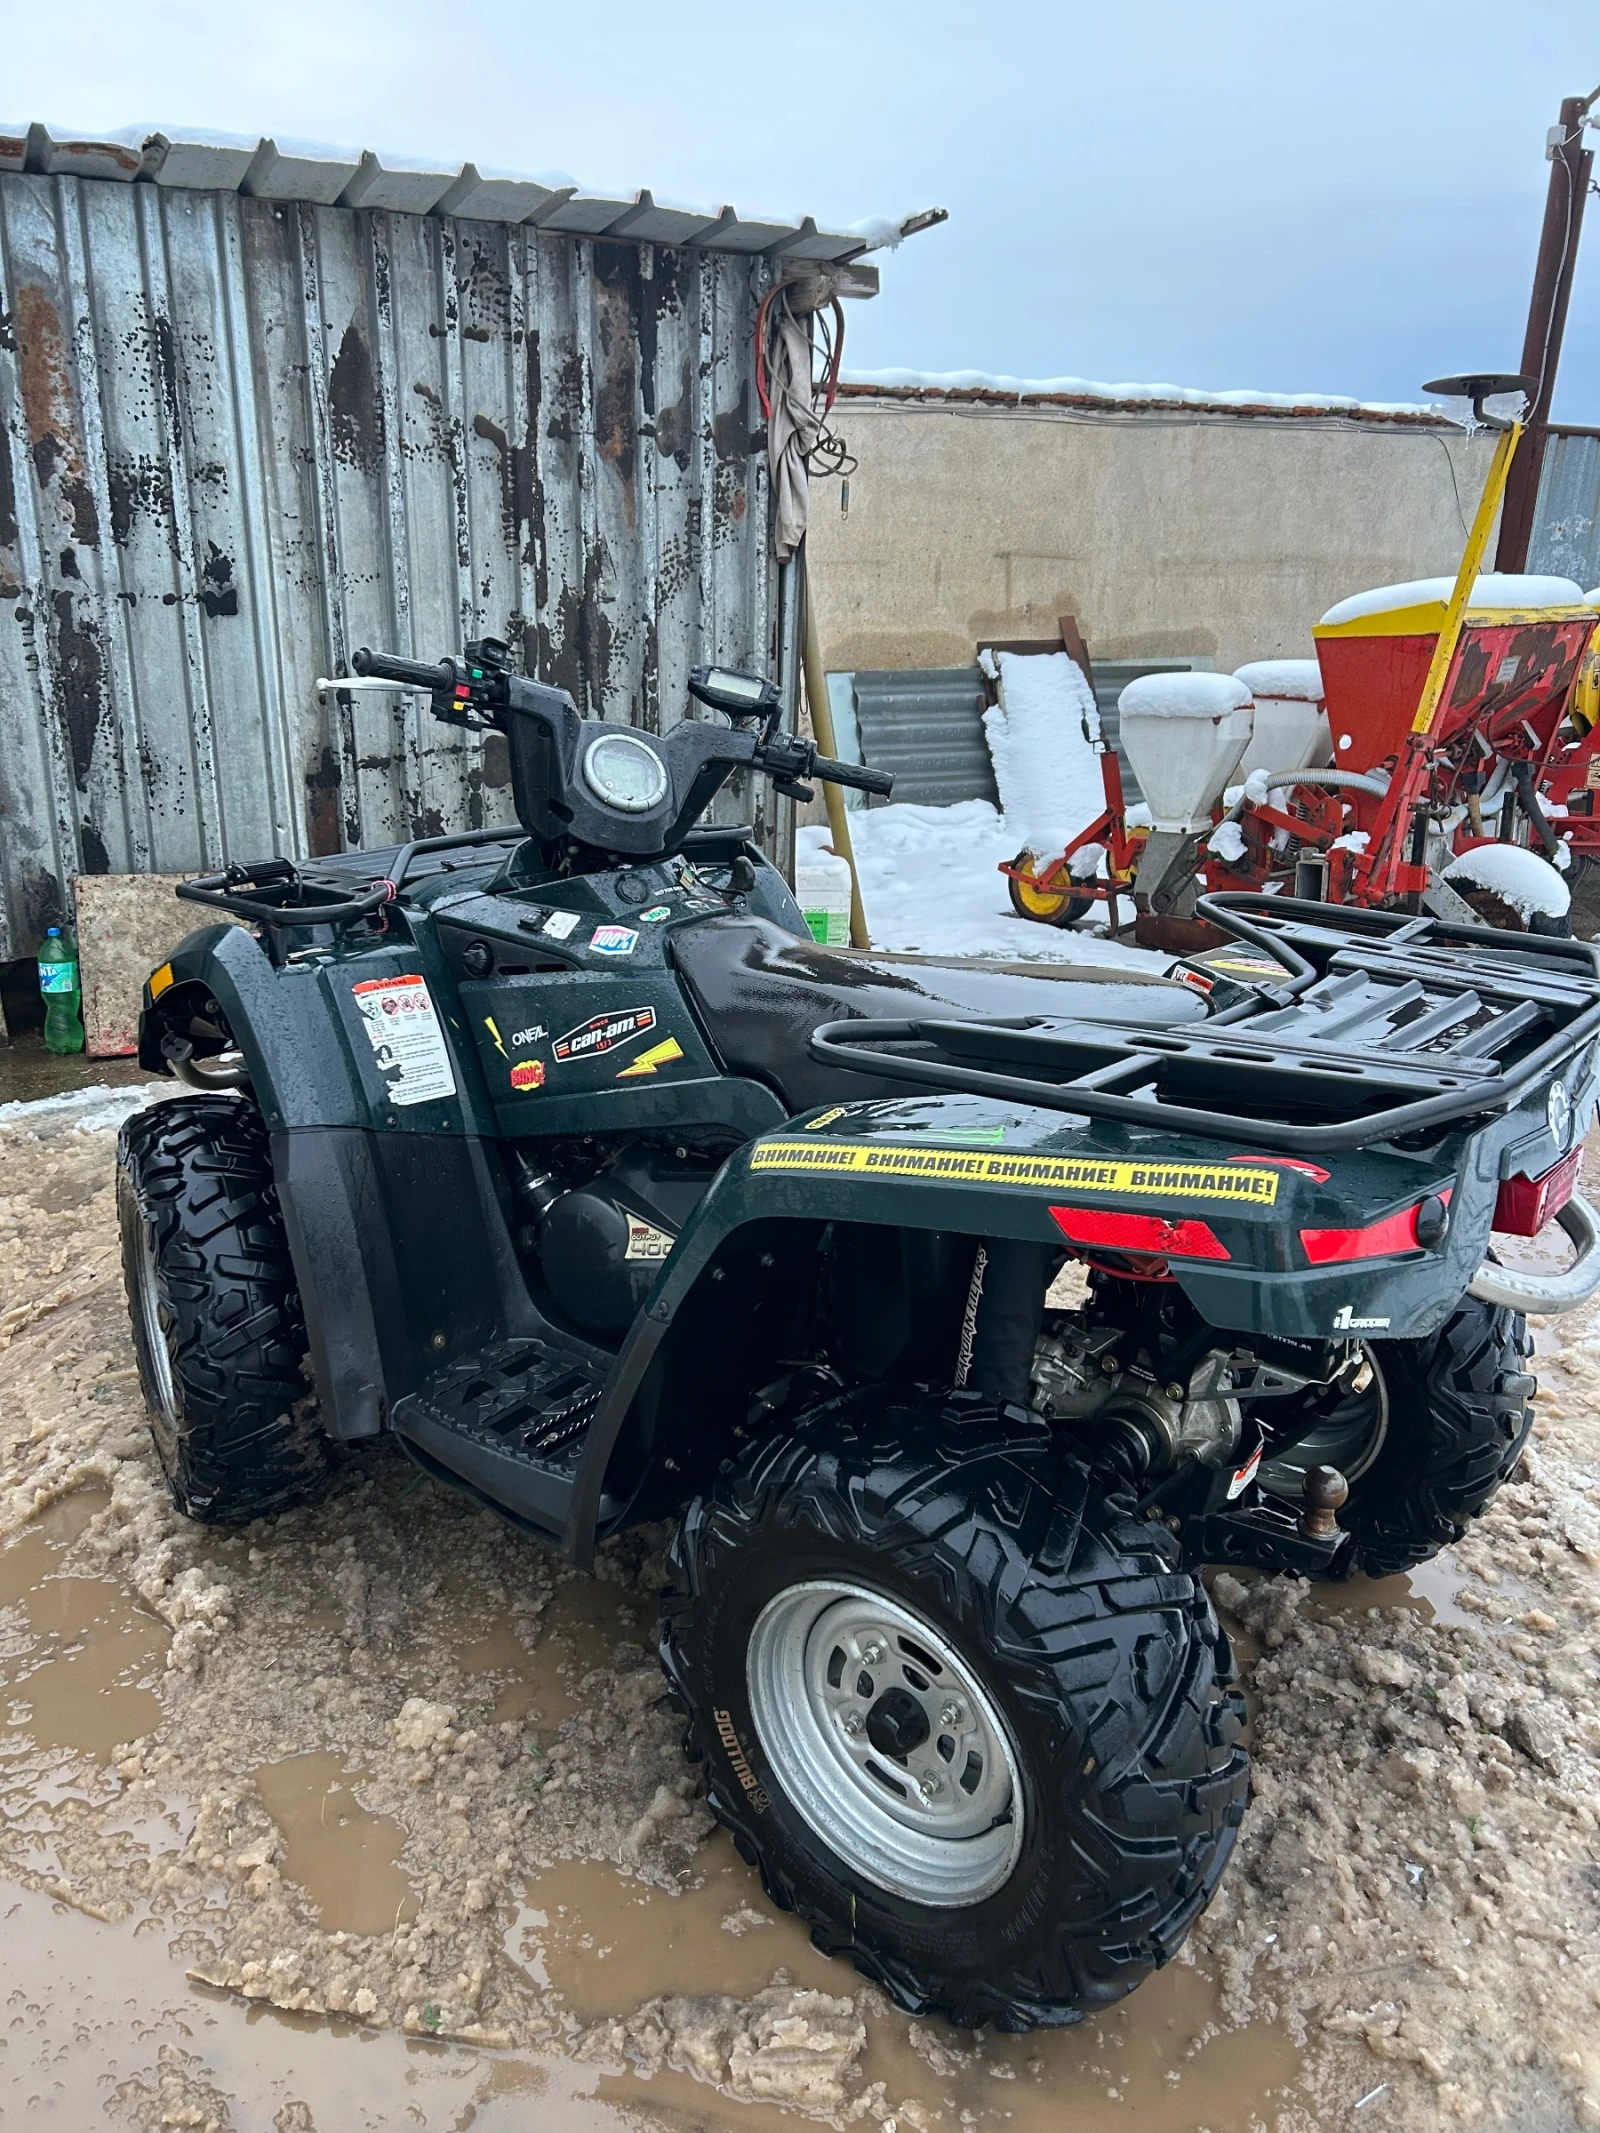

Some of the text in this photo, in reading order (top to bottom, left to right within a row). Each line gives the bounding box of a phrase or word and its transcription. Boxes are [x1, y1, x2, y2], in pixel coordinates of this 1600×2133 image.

[595, 930, 633, 949] 100%
[571, 1016, 636, 1052] can-am
[510, 1061, 546, 1087] BANG!
[753, 1149, 1274, 1196] ВНИМАНИЕ! ВНИМАНИЕ! ВНИМАНИЕ! ВНИМАНИЕ!
[713, 1709, 758, 1791] BULLDOG
